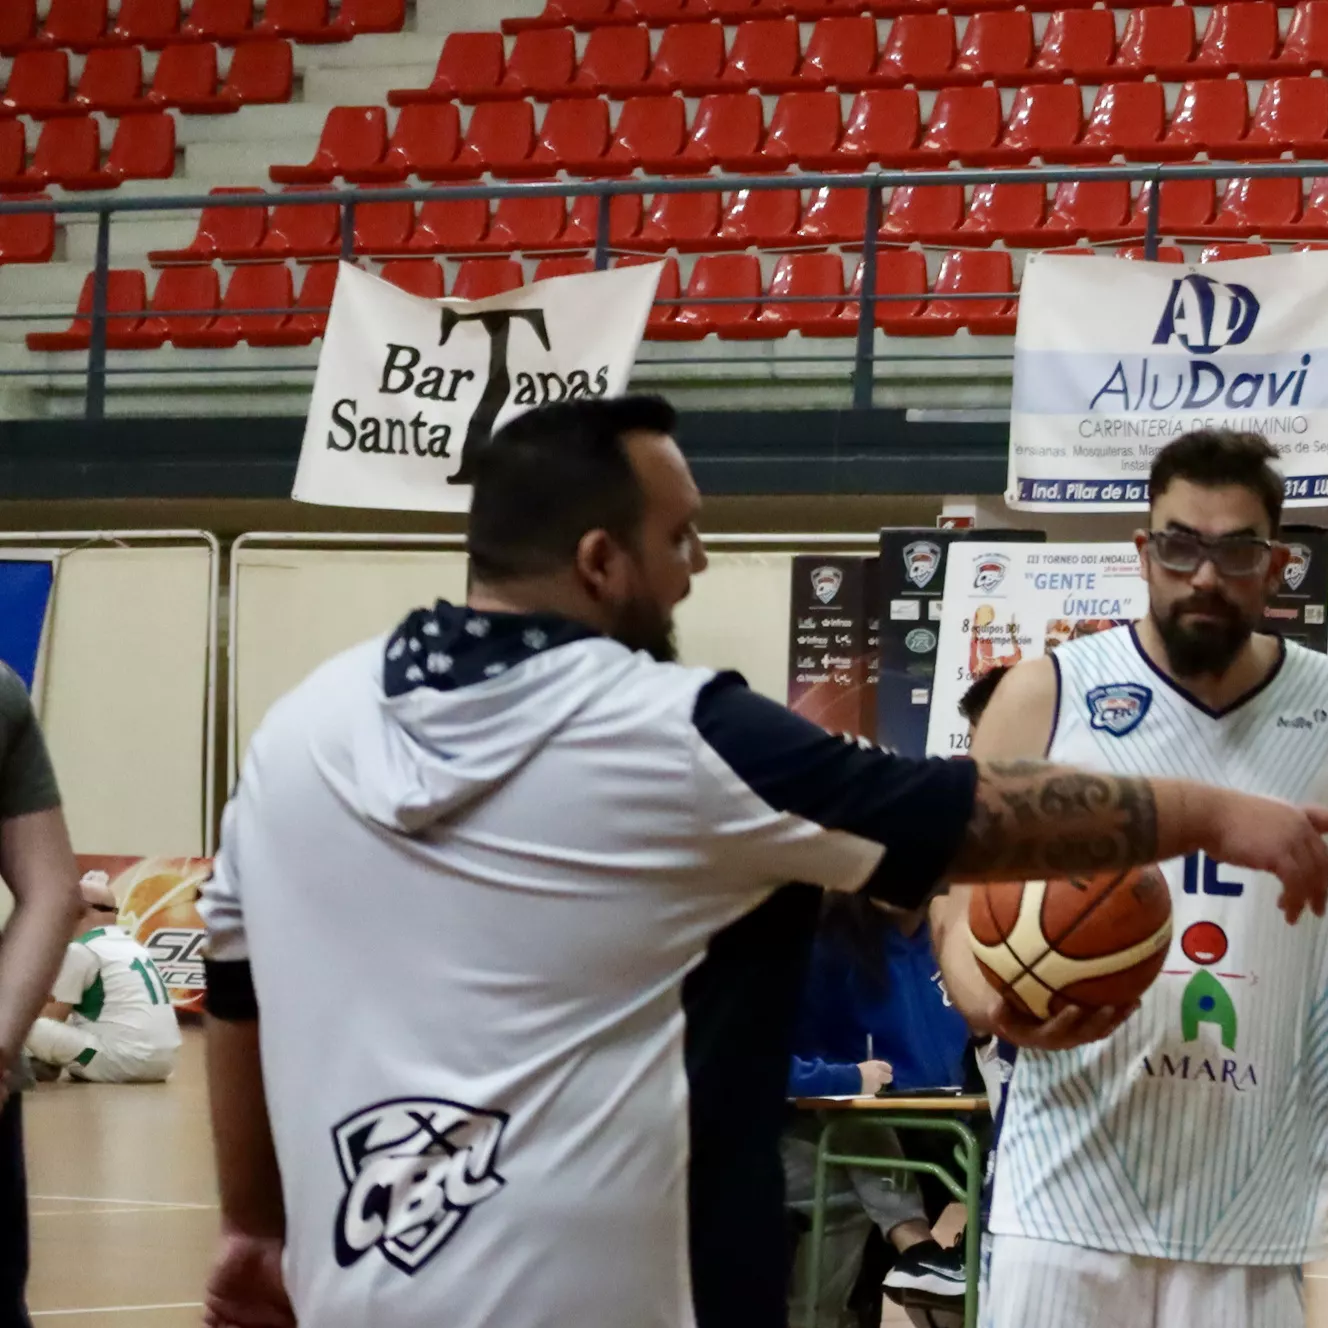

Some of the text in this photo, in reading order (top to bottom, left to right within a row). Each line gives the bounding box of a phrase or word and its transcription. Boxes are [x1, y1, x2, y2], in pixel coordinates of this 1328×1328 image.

[379, 343, 474, 402] Bar
[1089, 353, 1311, 411] AluDavi
[327, 399, 452, 460] Santa
[1078, 415, 1184, 439] CARPINTERÍA
[1031, 482, 1062, 499] Ind.
[1066, 480, 1098, 499] Pilar
[1101, 484, 1122, 500] de
[1125, 485, 1141, 500] la
[1139, 1053, 1259, 1092] AMARA
